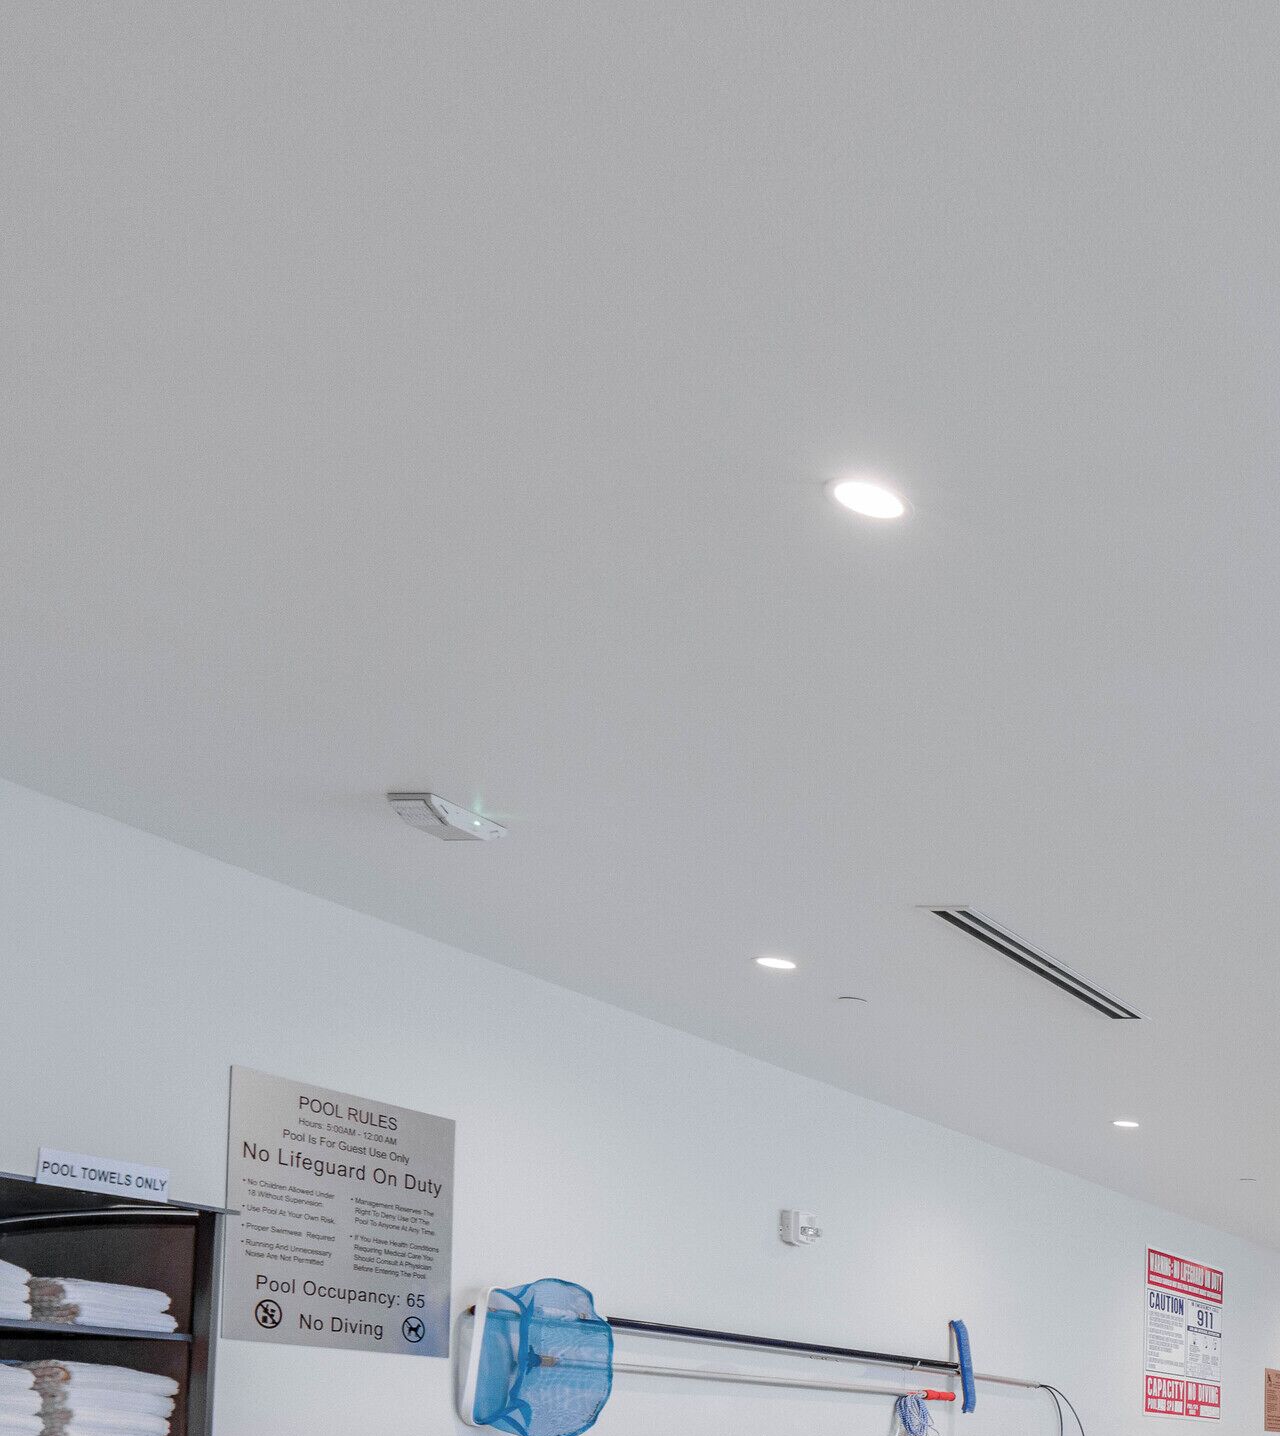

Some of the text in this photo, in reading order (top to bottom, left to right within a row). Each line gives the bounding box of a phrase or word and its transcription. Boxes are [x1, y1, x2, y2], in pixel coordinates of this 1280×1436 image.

[299, 1095, 398, 1131] POOL RULES
[283, 1129, 410, 1166] Pool Is For Guest Use Only
[384, 1136, 398, 1146] AM
[42, 1161, 167, 1192] POOL TOWELS ONLY
[243, 1141, 442, 1198] No Lifeguard On Duty
[247, 1204, 260, 1213] Use
[262, 1206, 277, 1215] Pool
[256, 1274, 426, 1309] Pool Occupancy: 65
[1149, 1291, 1184, 1316] CAUTION
[299, 1313, 383, 1340] No Diving
[1197, 1310, 1213, 1329] 911
[1147, 1377, 1184, 1400] CAPACITY
